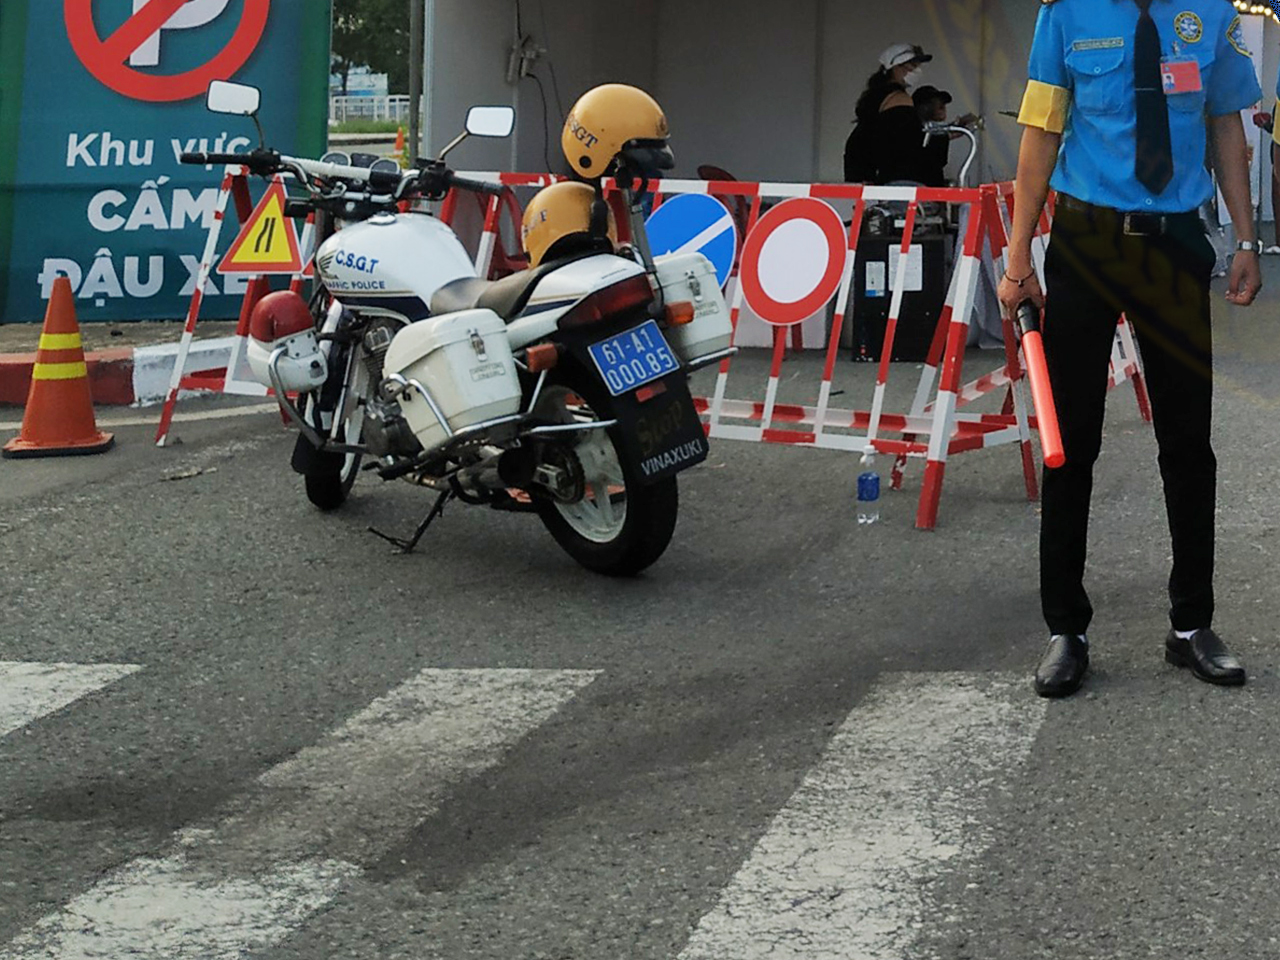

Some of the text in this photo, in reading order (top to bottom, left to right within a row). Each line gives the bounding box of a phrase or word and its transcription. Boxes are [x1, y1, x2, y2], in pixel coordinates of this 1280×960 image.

[66, 131, 154, 167] Khu
[87, 175, 220, 233] CẤM
[37, 247, 164, 308] ĐẬU
[351, 280, 386, 289] POLICE
[602, 327, 654, 365] 61-A1
[606, 346, 673, 391] 000.85
[641, 438, 703, 476] VINAXUKI
